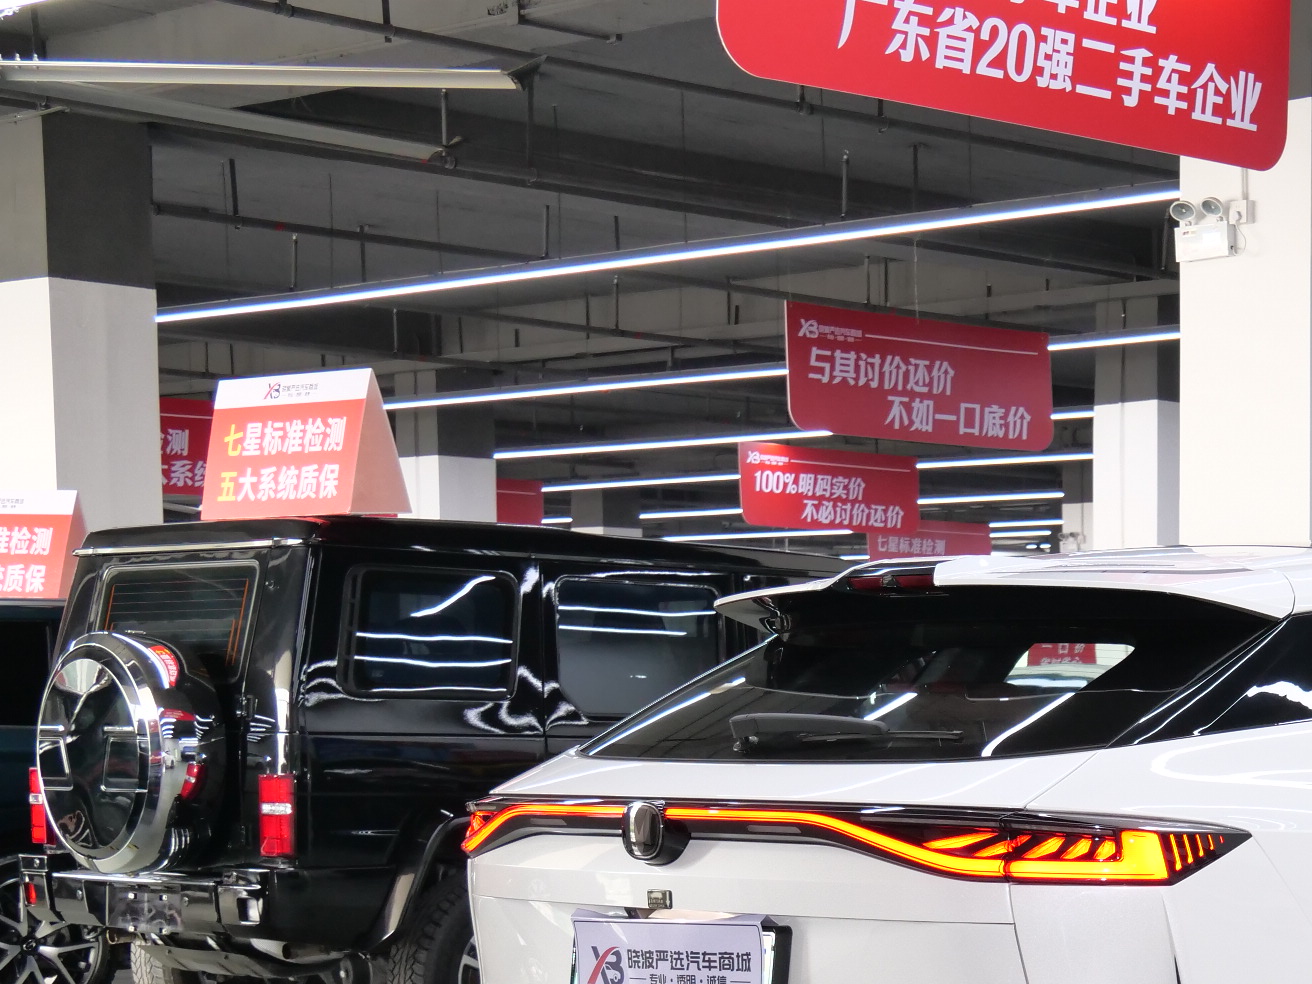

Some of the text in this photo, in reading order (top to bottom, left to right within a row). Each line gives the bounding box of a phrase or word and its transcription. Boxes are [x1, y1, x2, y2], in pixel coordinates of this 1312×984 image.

[838, 0, 1262, 131] 广东省20强二手车企业
[808, 346, 955, 396] 与其讨价还价
[224, 416, 346, 456] 七星标准检测
[884, 395, 1031, 440] 不如一口底价
[217, 464, 339, 502] 五大系统质保
[754, 470, 865, 501] 100%明码实价
[802, 500, 904, 529] 不必讨价还价
[0, 564, 46, 593] 质保
[627, 949, 752, 972] 晓波严选汽车商城
